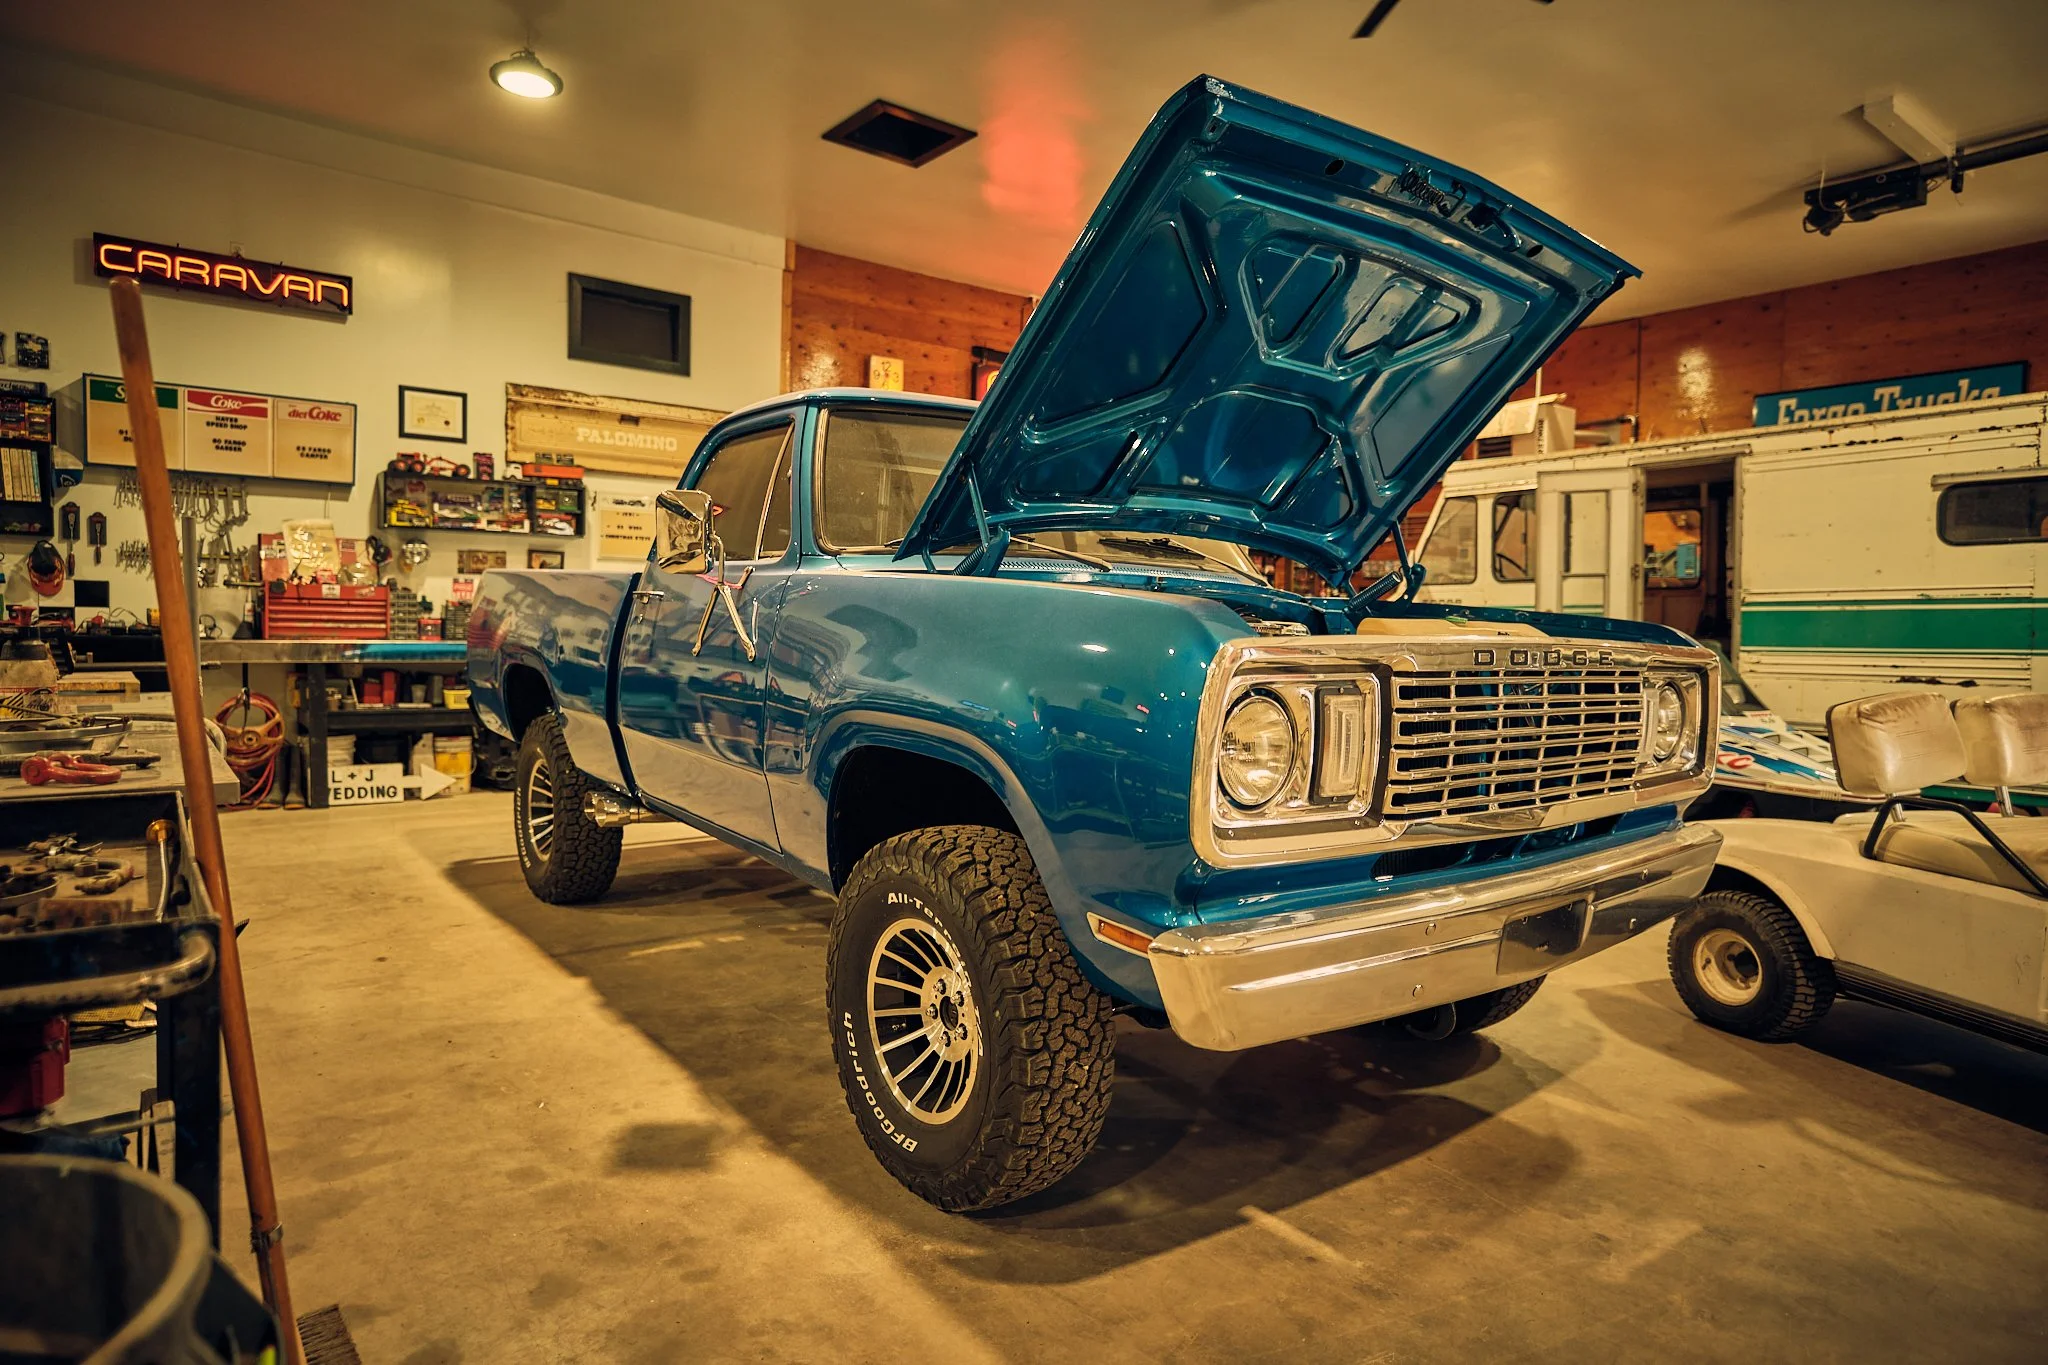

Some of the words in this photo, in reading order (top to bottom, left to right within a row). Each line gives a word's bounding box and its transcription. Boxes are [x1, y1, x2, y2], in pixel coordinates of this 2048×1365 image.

[99, 242, 350, 308] CARAVAN
[210, 394, 243, 410] Coke
[308, 405, 342, 422] Coke
[205, 421, 229, 429] SPEED
[229, 423, 248, 431] SHOP
[224, 438, 247, 447] FARGO
[576, 425, 678, 453] PALOMINO
[299, 452, 329, 460] CAMPER
[1472, 648, 1615, 667] DODGE
[331, 769, 343, 783] L
[365, 769, 374, 782] J
[328, 785, 398, 801] EDDING
[842, 1011, 919, 1153] BFGoodrich
